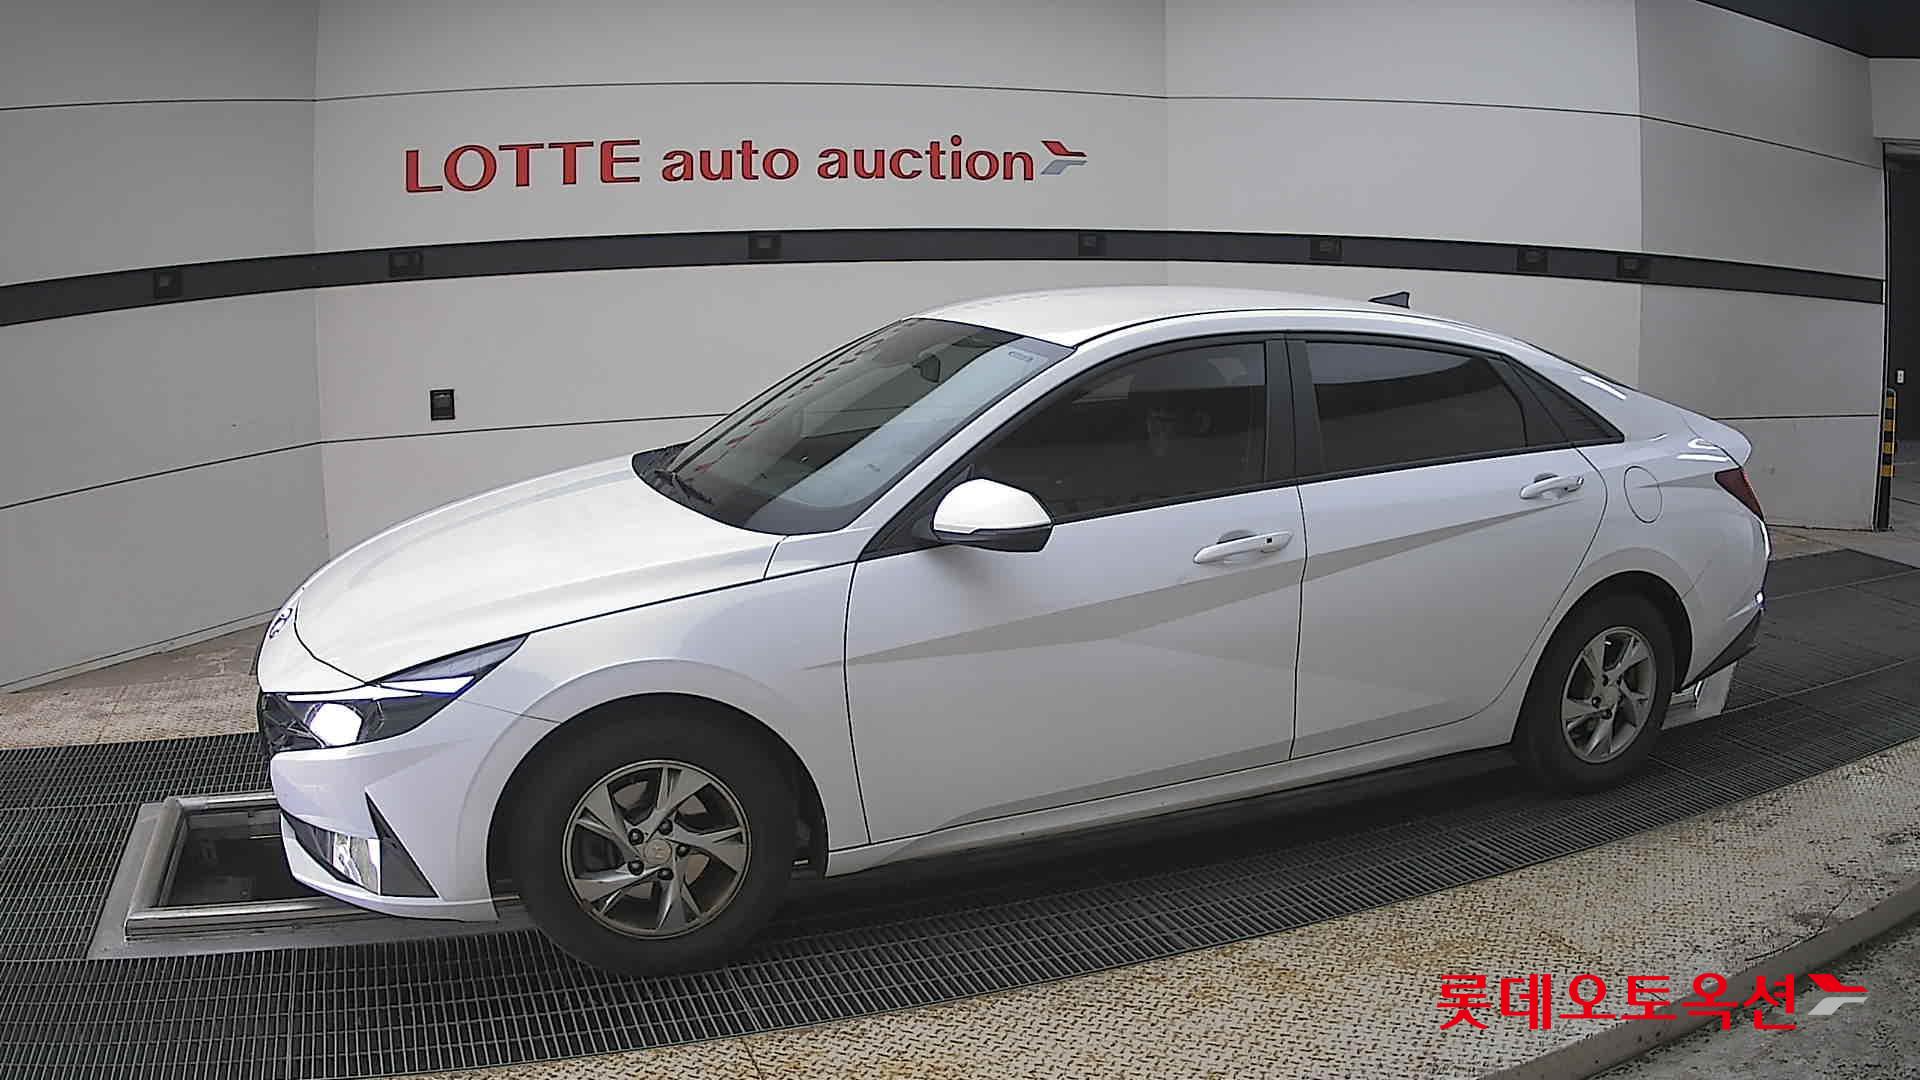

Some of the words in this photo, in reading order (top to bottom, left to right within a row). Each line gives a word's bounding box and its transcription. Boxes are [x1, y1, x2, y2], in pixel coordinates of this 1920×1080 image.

[405, 139, 641, 193] LOTTE
[661, 140, 800, 182] auto
[816, 135, 1035, 181] auction
